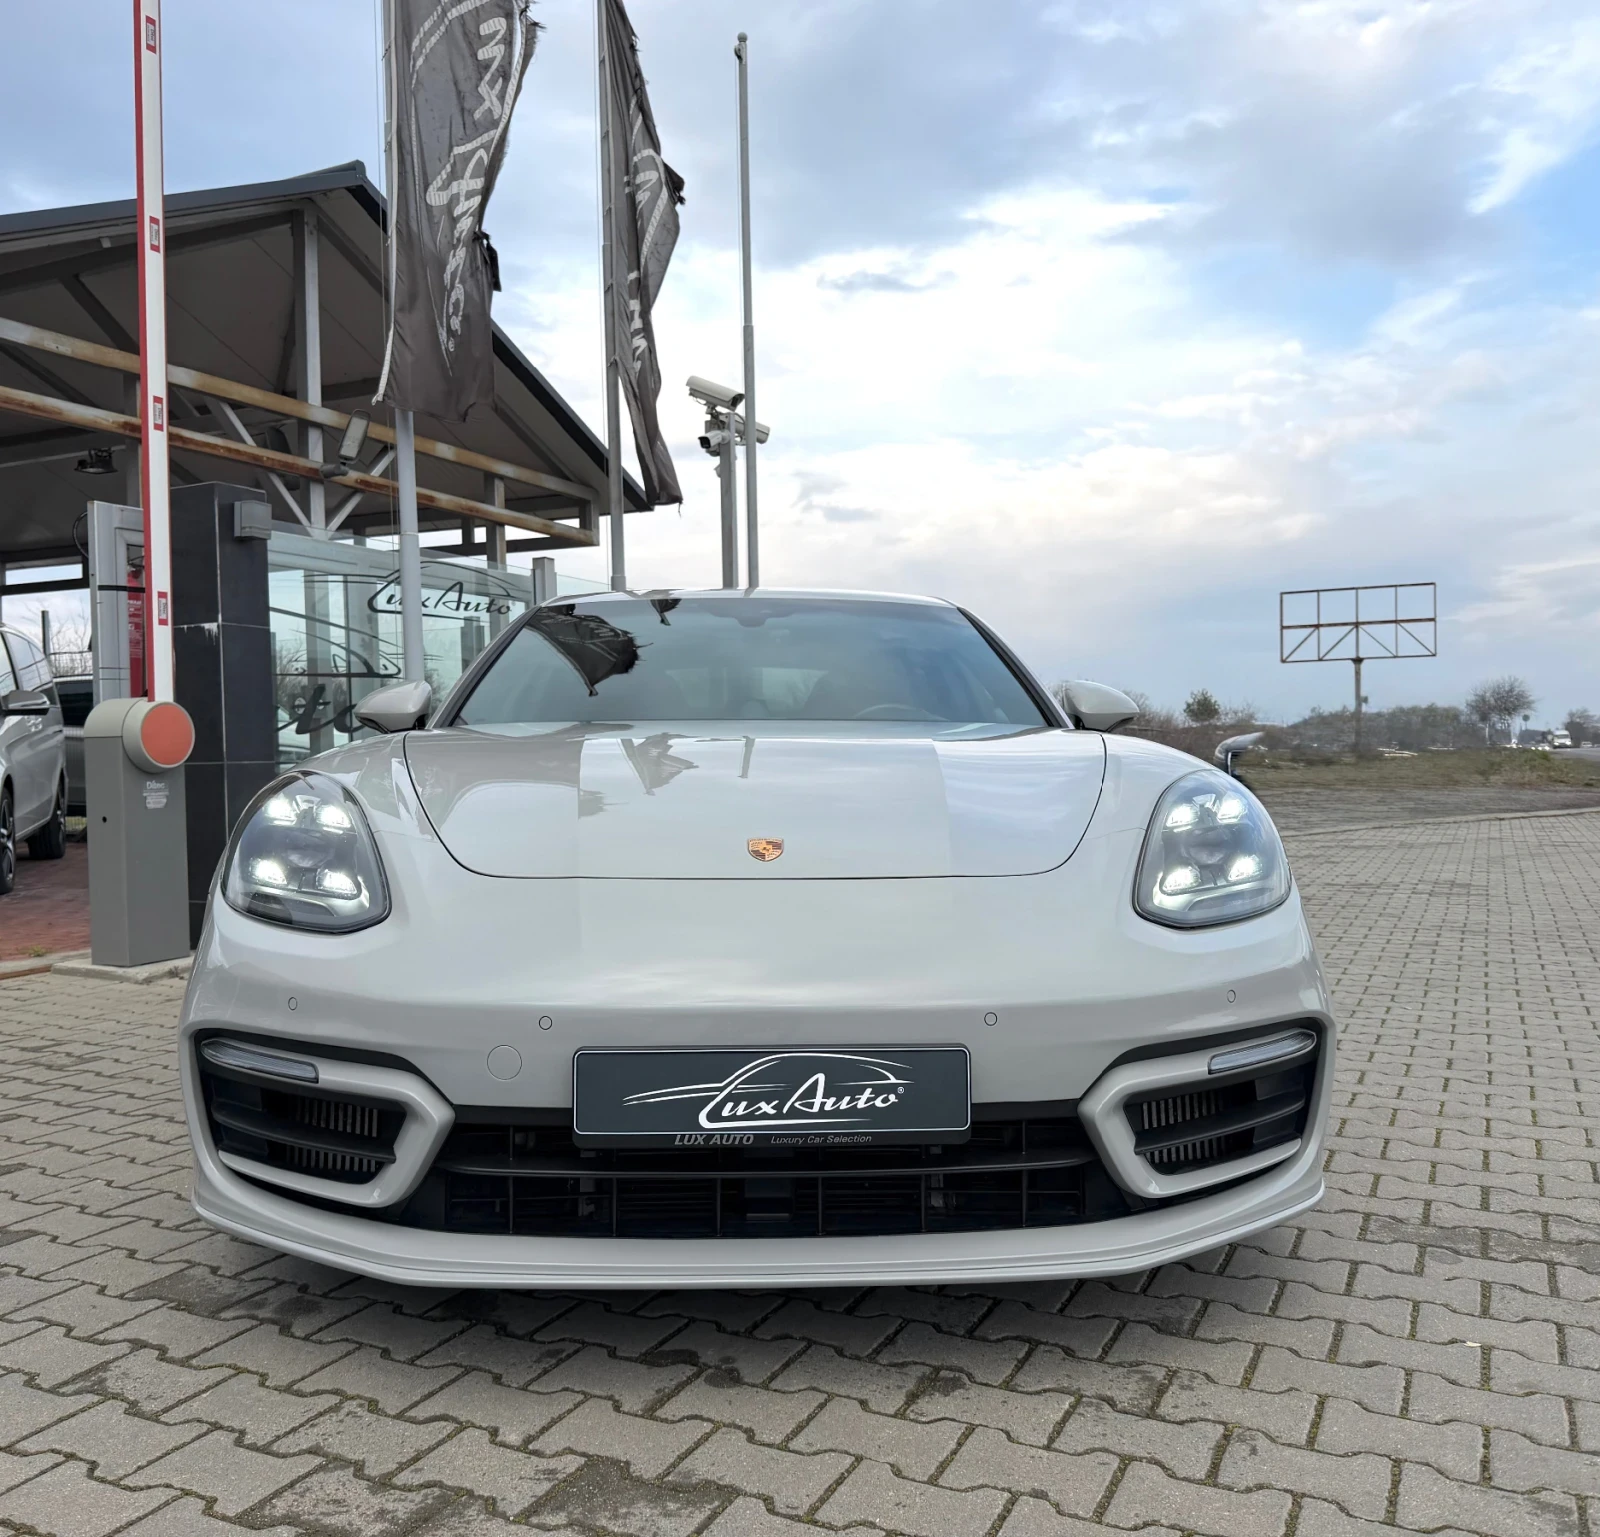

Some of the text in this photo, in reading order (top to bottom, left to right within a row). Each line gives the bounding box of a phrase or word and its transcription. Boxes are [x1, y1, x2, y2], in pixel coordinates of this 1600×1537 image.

[674, 1133, 754, 1146] LUX AUTO
[770, 1134, 872, 1145] Luxury Car Selection
